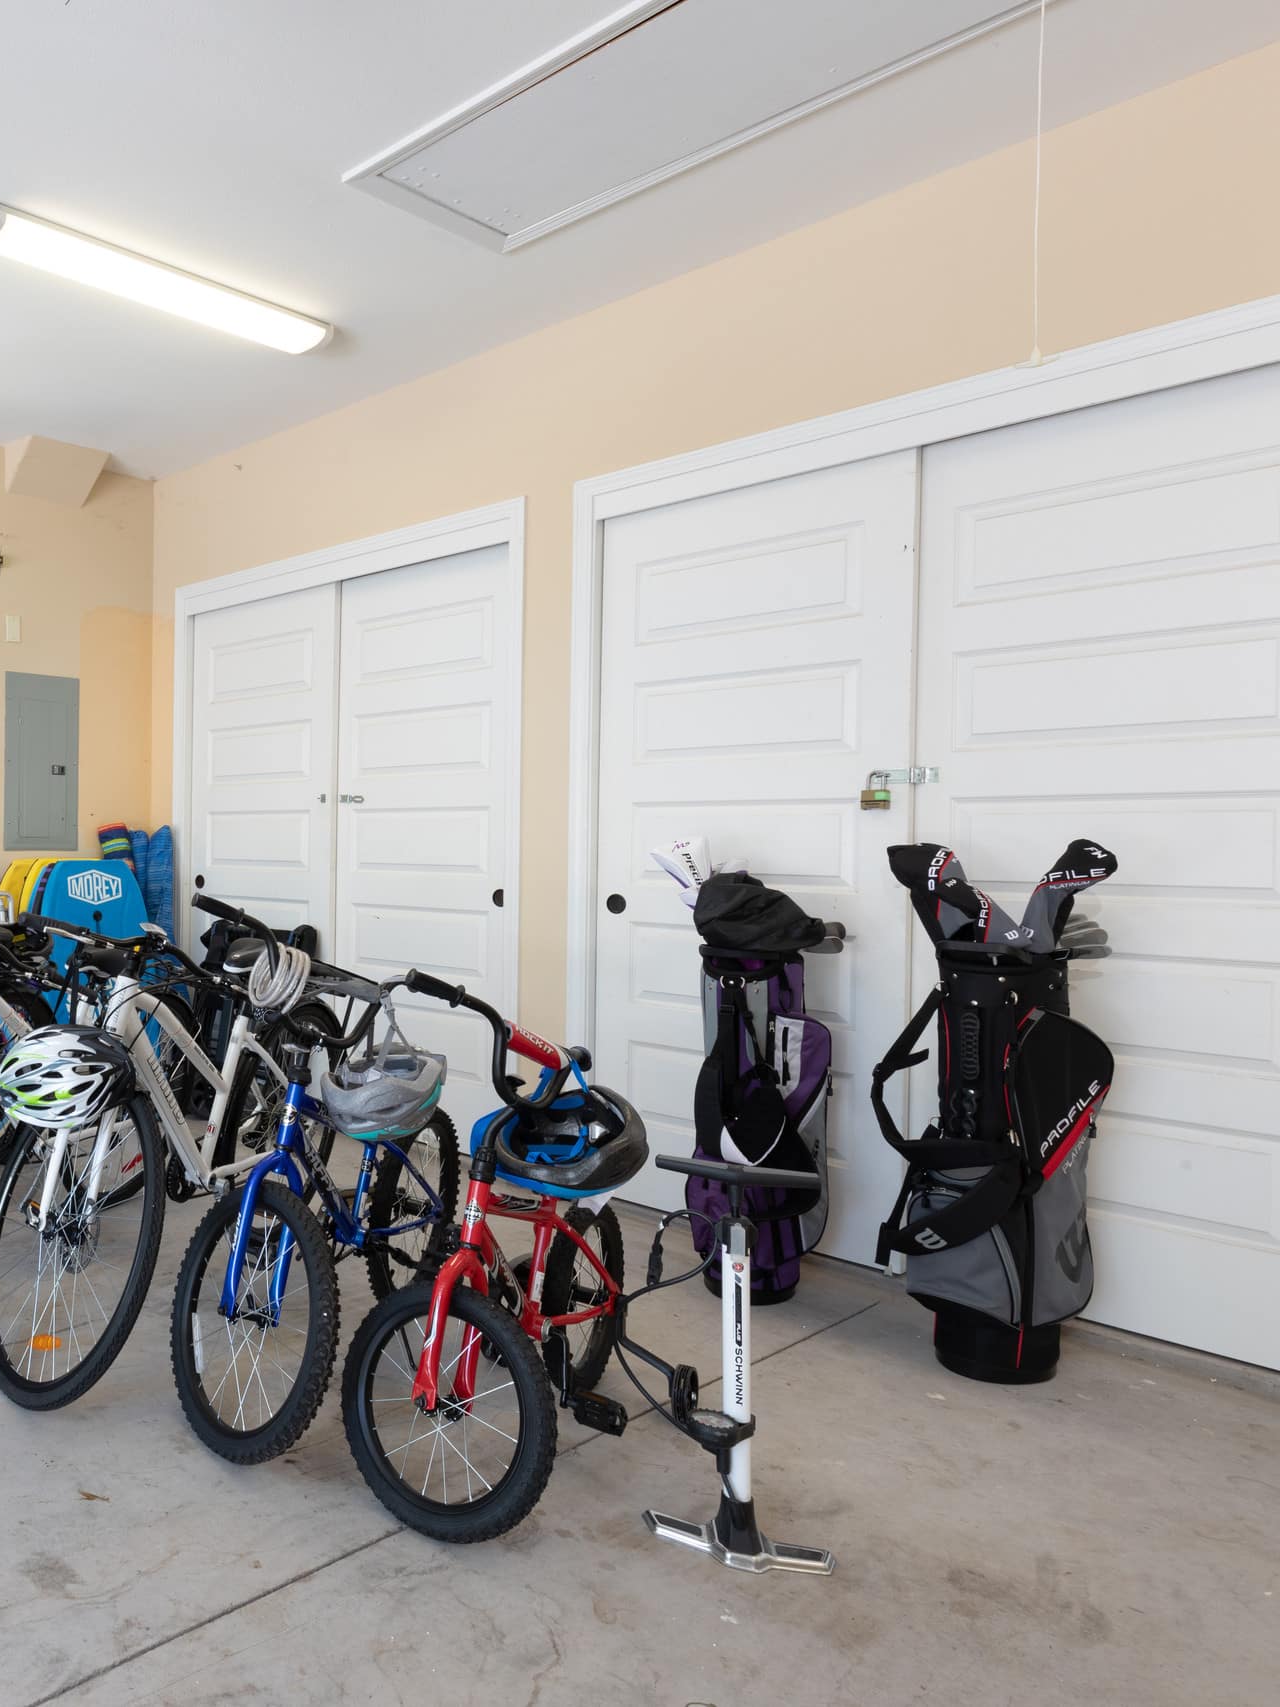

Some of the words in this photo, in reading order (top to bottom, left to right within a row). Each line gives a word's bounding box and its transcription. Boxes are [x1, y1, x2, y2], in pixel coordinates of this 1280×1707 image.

[71, 873, 117, 901] MOREY
[1040, 1079, 1101, 1158] PROFILE
[735, 1348, 744, 1406] SCHWINN
